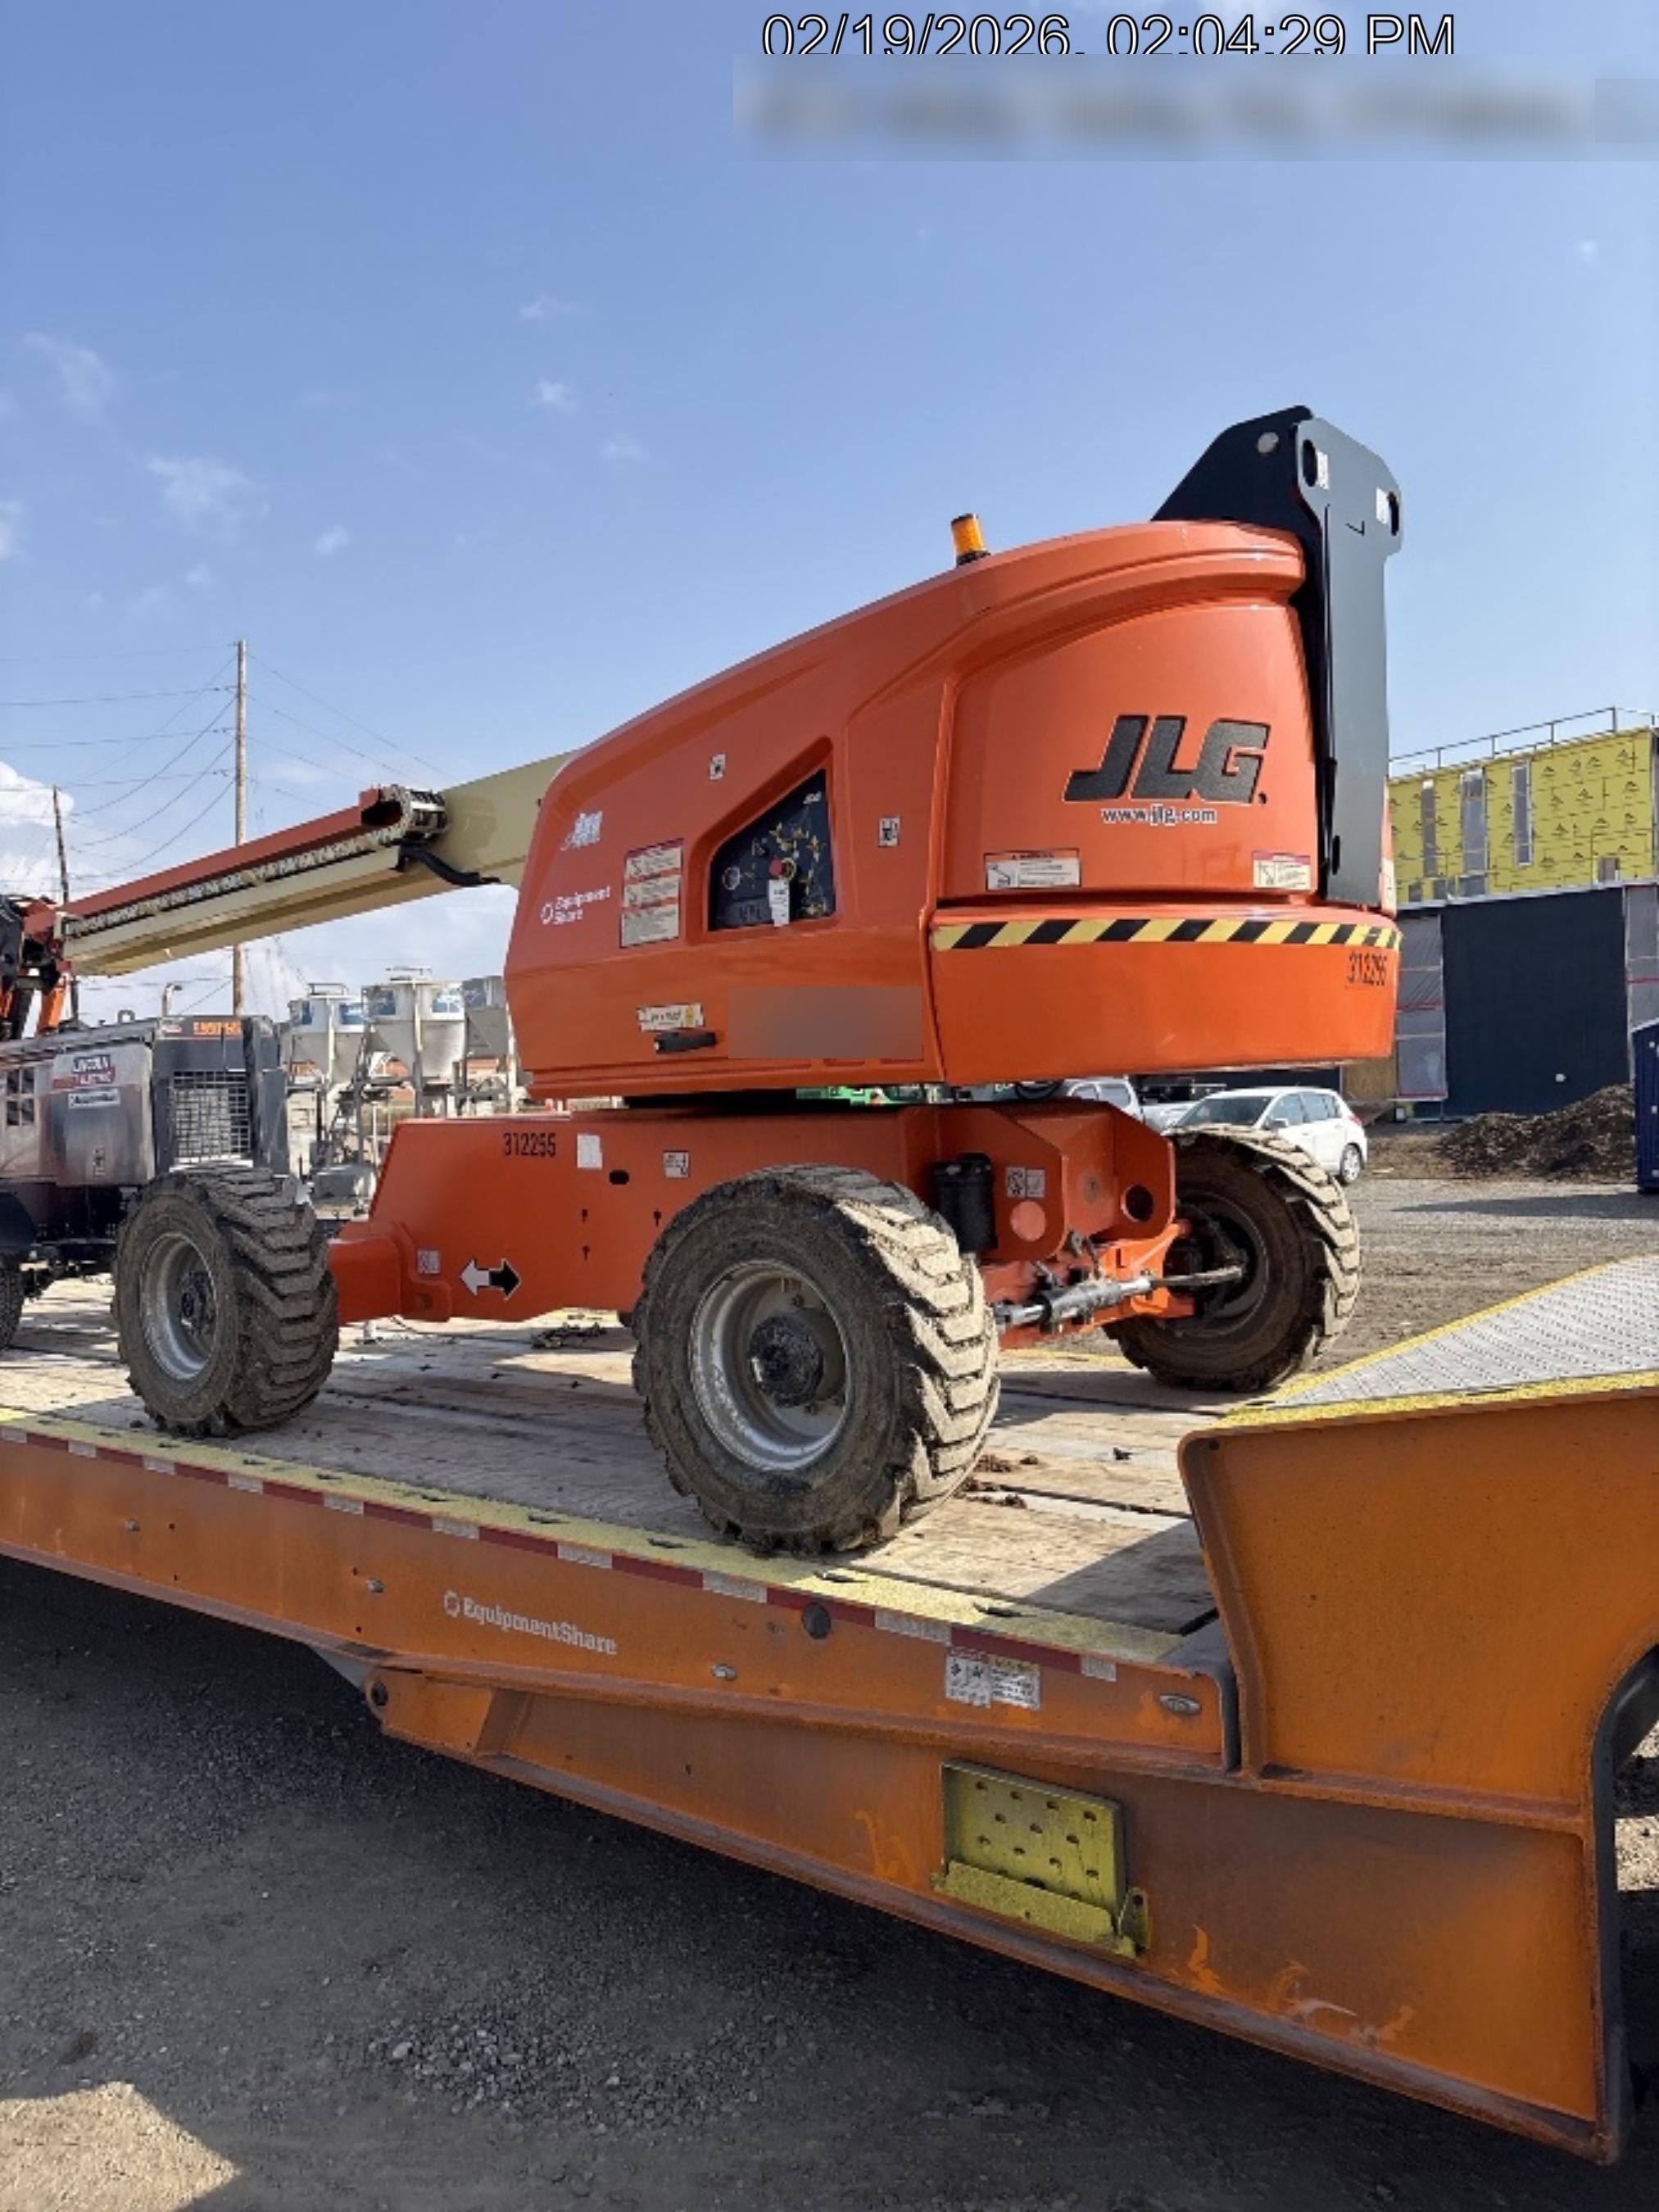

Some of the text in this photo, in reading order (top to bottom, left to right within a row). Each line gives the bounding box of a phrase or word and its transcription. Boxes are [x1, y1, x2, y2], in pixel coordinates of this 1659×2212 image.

[1063, 714, 1271, 806] JLG
[1102, 804, 1217, 825] www.jlg.com
[502, 1132, 557, 1158] 312255
[463, 1597, 618, 1655] EquipmentShare
